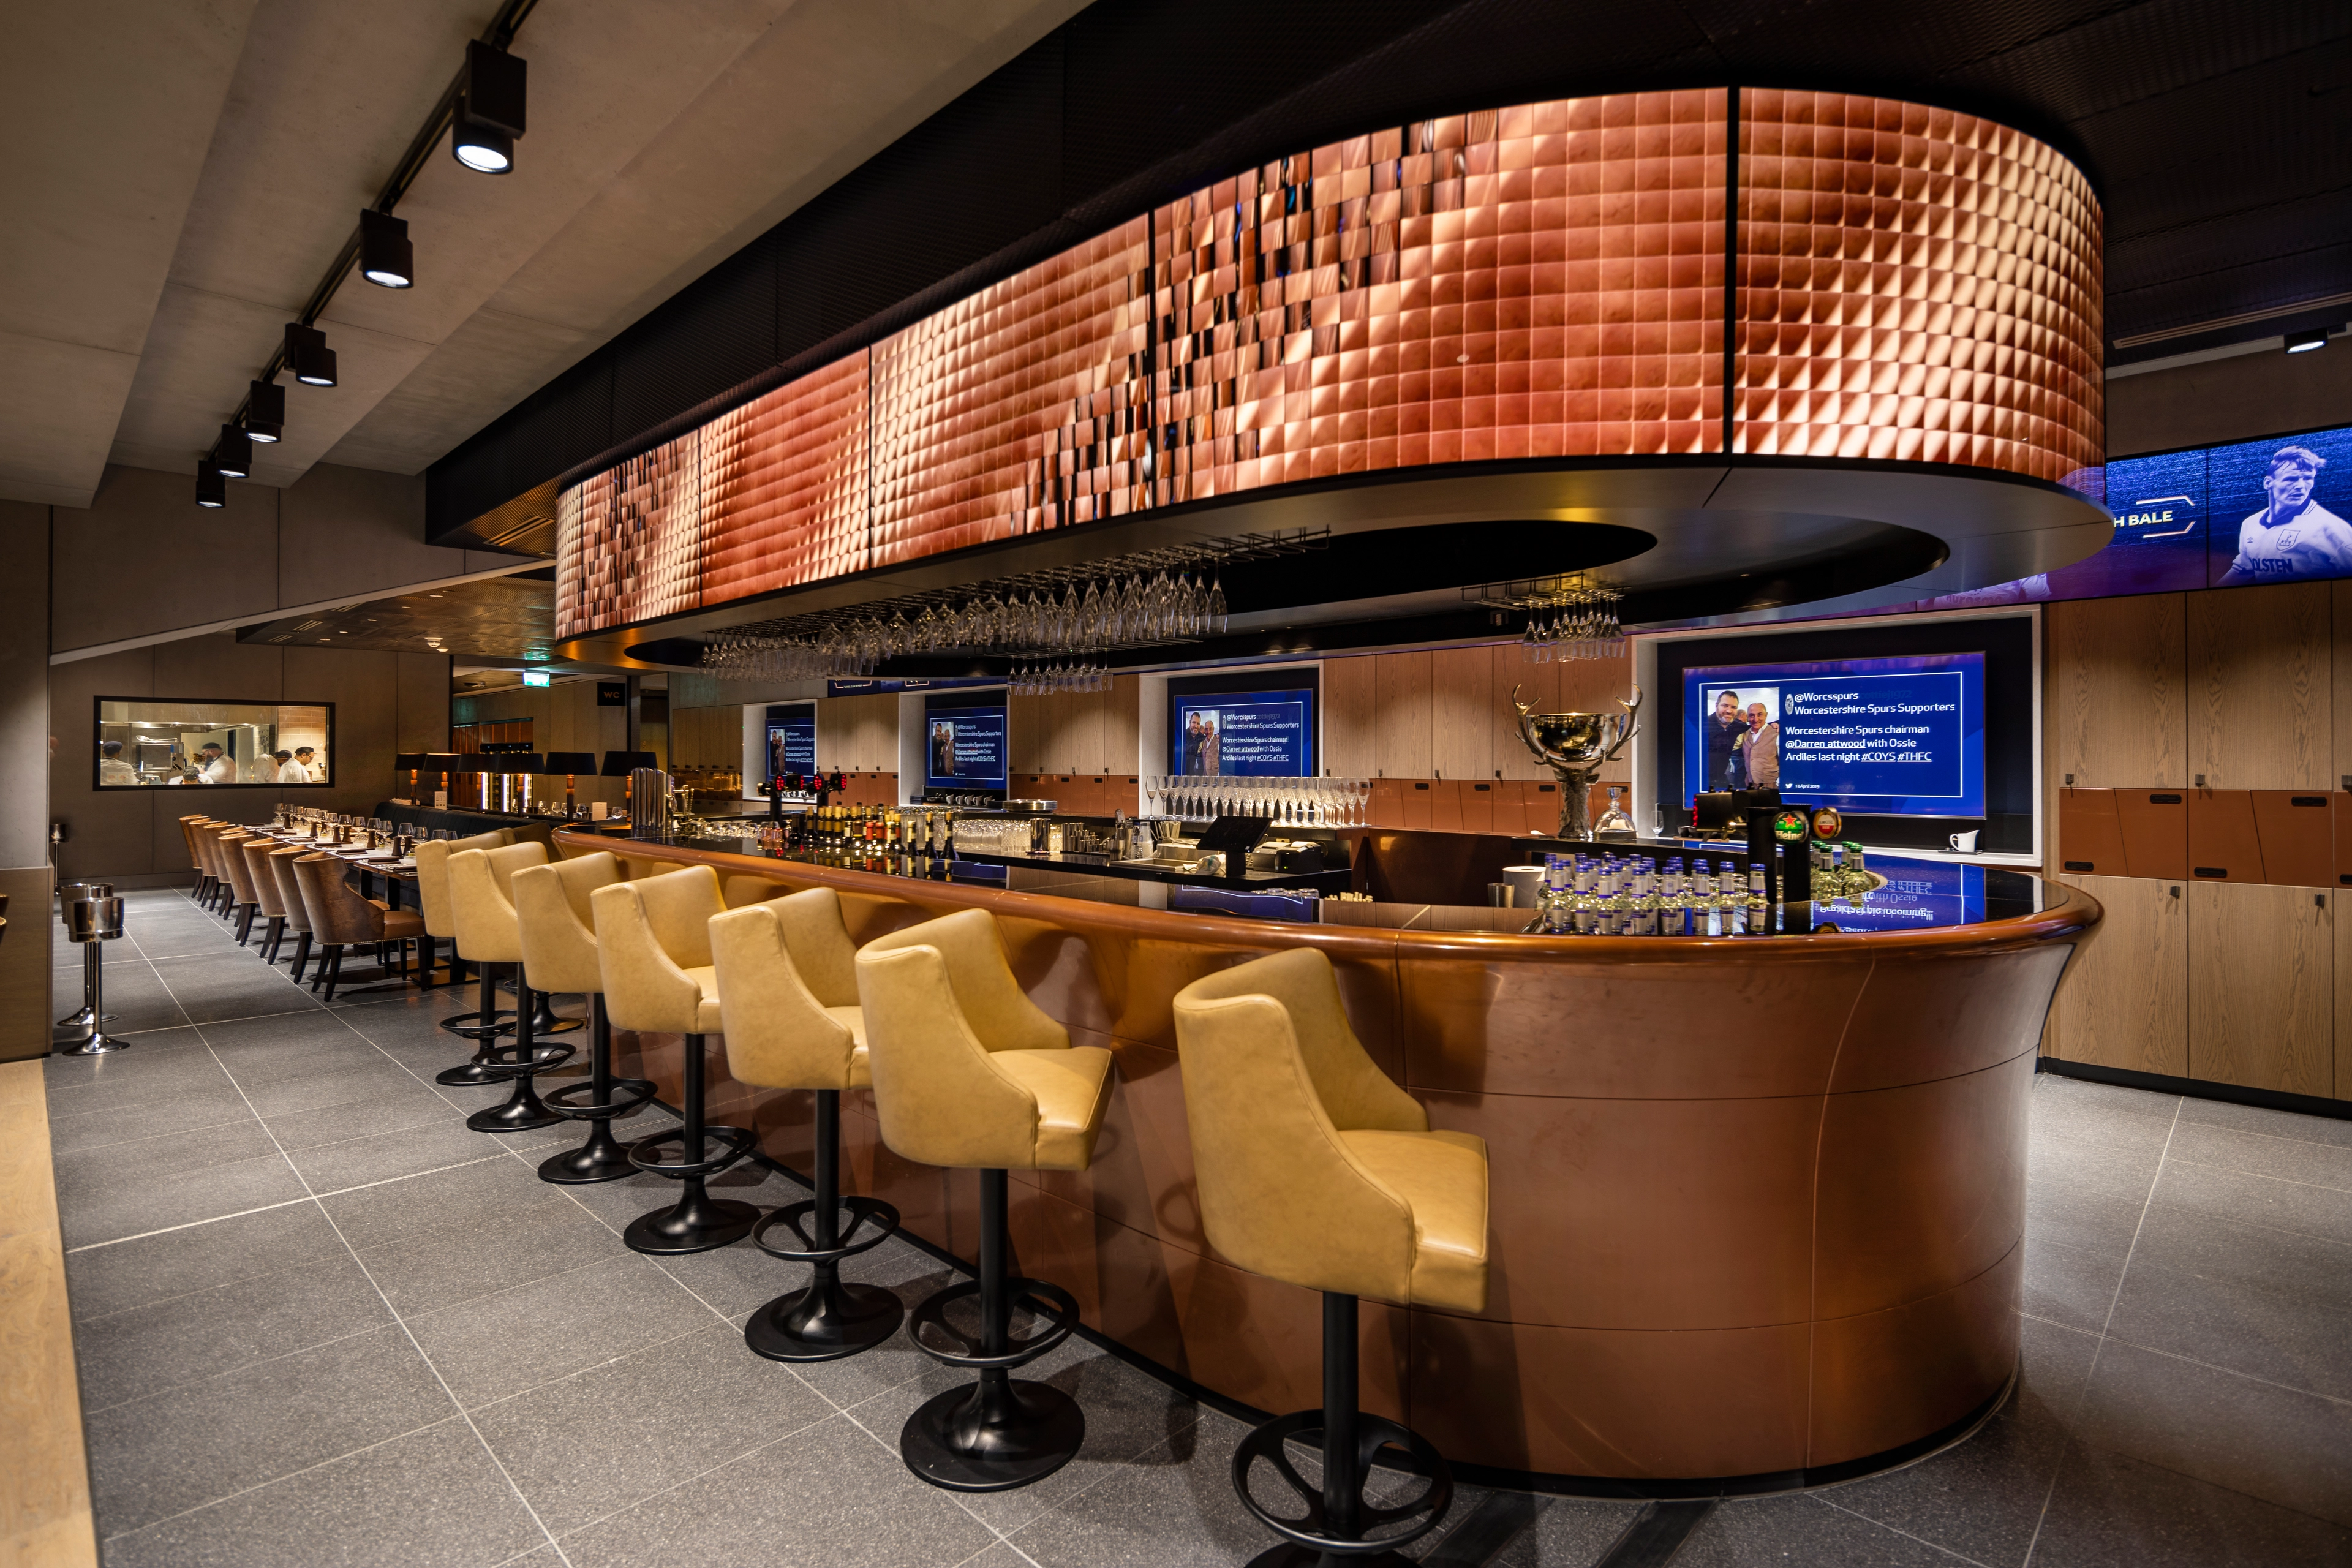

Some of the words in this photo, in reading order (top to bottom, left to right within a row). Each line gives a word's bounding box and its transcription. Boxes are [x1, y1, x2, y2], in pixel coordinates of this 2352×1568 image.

[2128, 510, 2173, 526] BALE
[1794, 692, 1859, 703] @Worcsspurs
[1795, 704, 1866, 715] Worcestershire
[1867, 704, 1896, 715] Spurs
[1898, 703, 1955, 714] Supporters
[1785, 726, 1854, 735] Worcestershire
[1855, 725, 1883, 736] Spurs
[1885, 725, 1929, 734] chairman
[1889, 739, 1917, 747] Ossie
[1836, 753, 1860, 763] night
[1861, 752, 1896, 762] #COYS
[1897, 752, 1932, 762] #THFC
[1775, 831, 1804, 840] Heine
